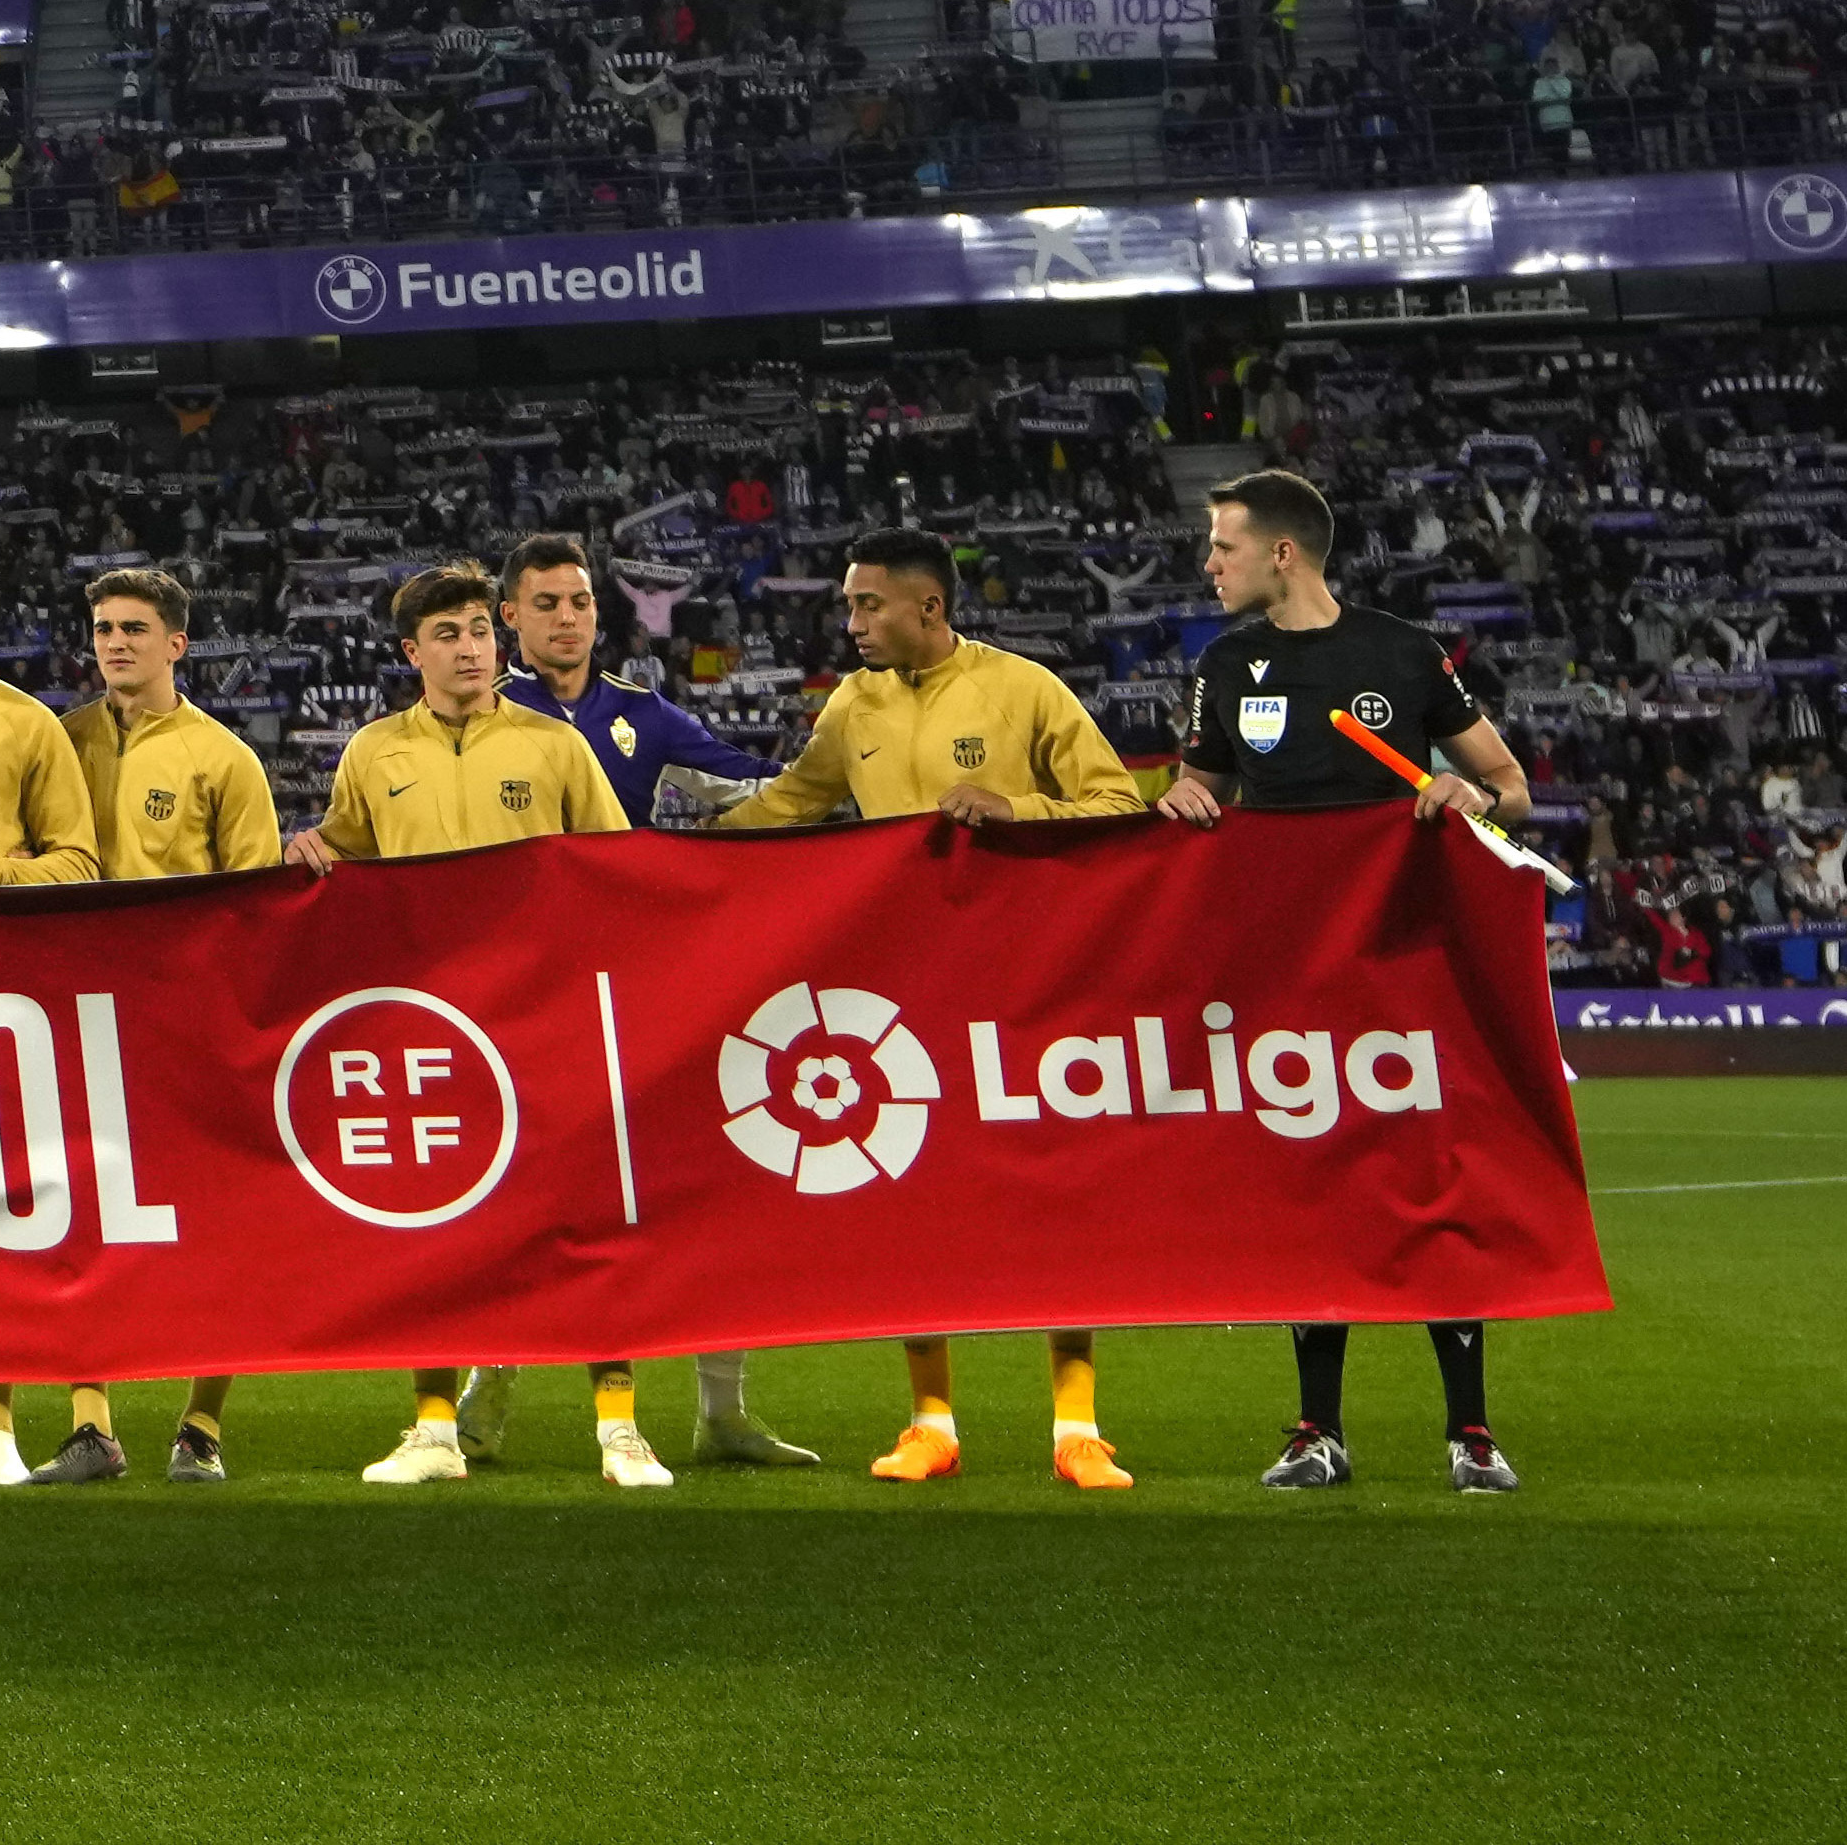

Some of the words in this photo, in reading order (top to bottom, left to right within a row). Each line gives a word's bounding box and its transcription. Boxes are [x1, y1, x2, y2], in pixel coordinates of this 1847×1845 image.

[397, 249, 705, 309] Fuenteolid
[1245, 700, 1281, 714] FIFA
[328, 1046, 454, 1097] RF
[967, 1000, 1443, 1139] LaLiga
[339, 1115, 461, 1165] EF
